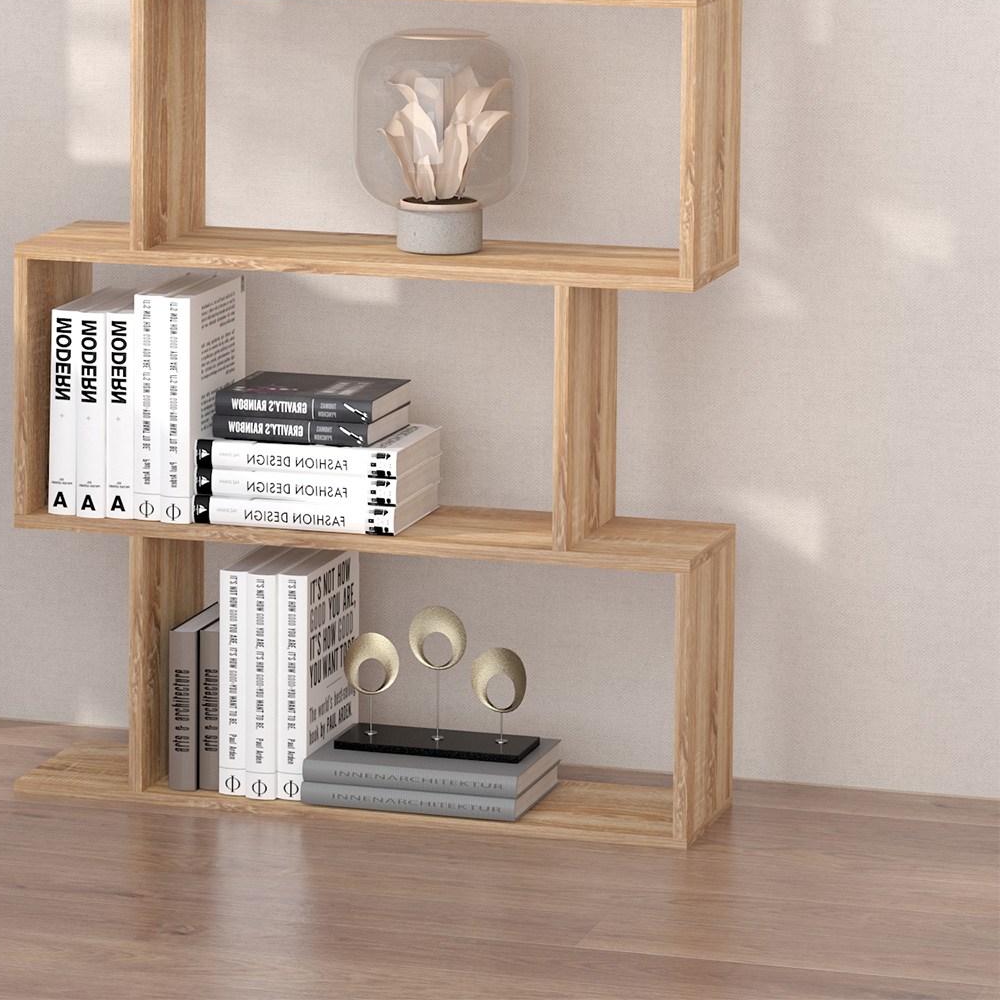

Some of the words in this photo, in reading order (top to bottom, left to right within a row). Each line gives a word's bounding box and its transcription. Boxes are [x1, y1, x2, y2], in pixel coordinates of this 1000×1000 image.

[53, 491, 68, 508] A
[81, 494, 96, 511] A
[110, 495, 126, 512] A
[310, 576, 322, 606] IT'S
[323, 567, 335, 597] NOT
[337, 557, 351, 587] HOW
[310, 601, 326, 633] GOOD
[328, 591, 340, 620] YOU
[310, 632, 322, 661] IT'S
[323, 621, 336, 652] HOW
[338, 610, 353, 642] GOOD
[310, 659, 321, 688] YOU
[322, 647, 338, 680] WANT
[171, 669, 190, 721] architecture
[202, 669, 218, 721] architecture
[173, 735, 190, 753] arts
[202, 735, 218, 752] arts
[333, 770, 504, 790] INNENARCHITEKTUR
[331, 793, 502, 813] INNENARCHITEKTUR
